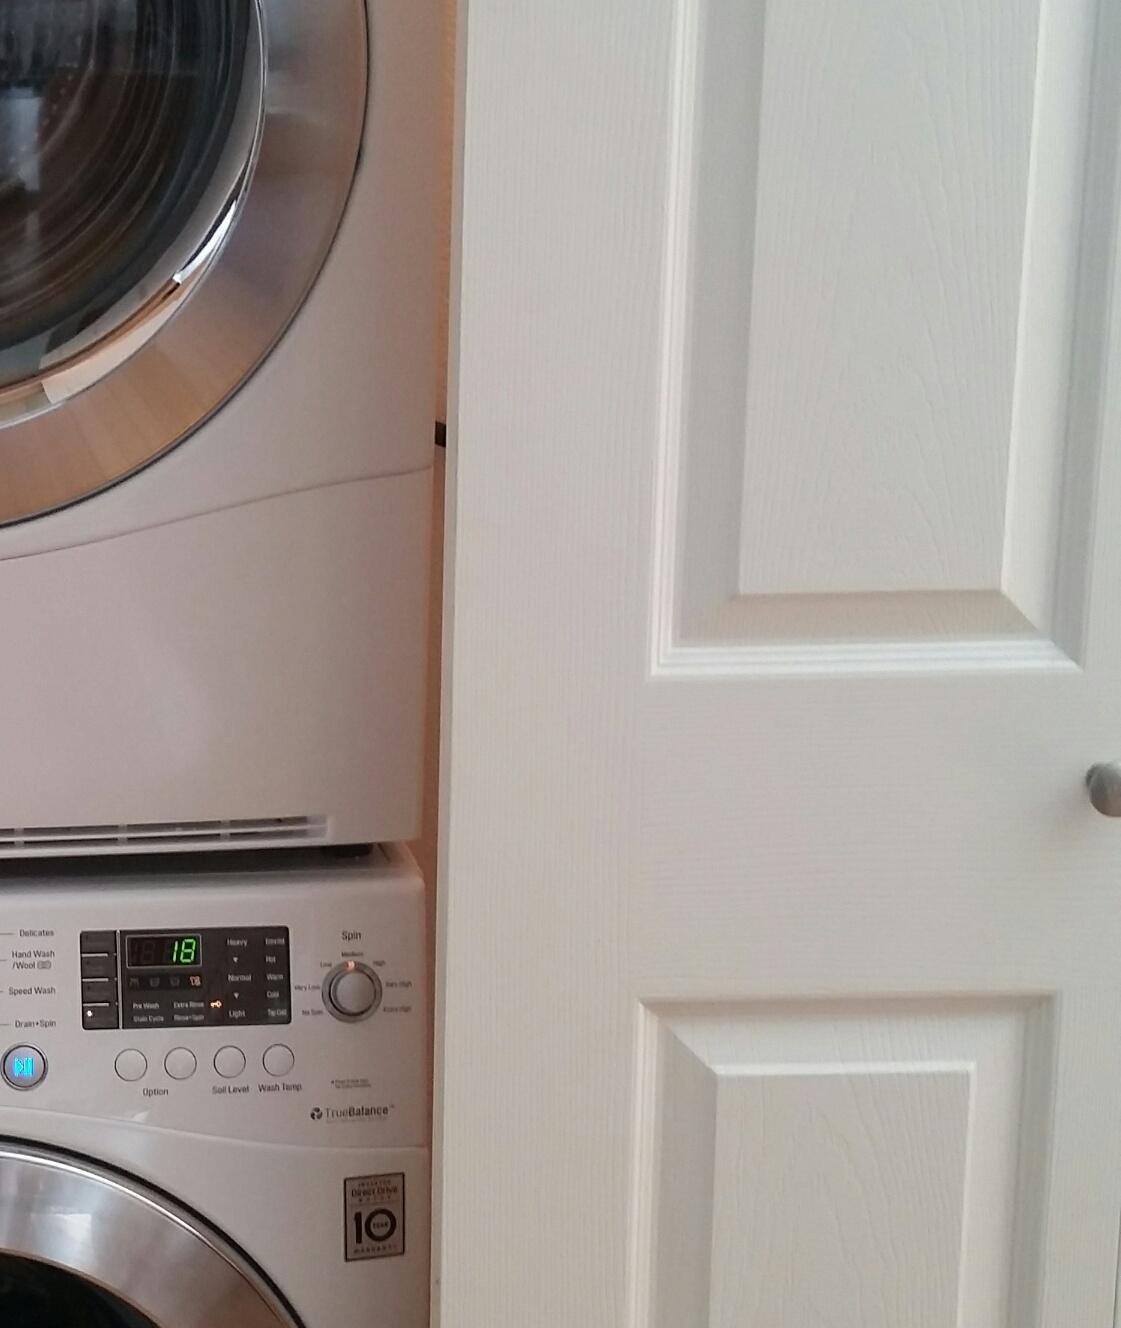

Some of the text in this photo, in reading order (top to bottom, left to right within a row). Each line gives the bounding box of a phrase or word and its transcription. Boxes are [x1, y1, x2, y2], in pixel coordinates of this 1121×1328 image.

[19, 929, 54, 937] Delicates
[342, 930, 362, 941] Spin
[12, 950, 55, 958] Hand Wash
[172, 939, 196, 963] 18
[12, 961, 36, 970] /Wool
[8, 986, 56, 996] Speed Wash
[228, 1010, 246, 1018] Light
[143, 1088, 169, 1097] Option
[212, 1085, 250, 1094] Soil Level
[258, 1083, 280, 1093] Wash
[354, 1208, 397, 1244] 10
